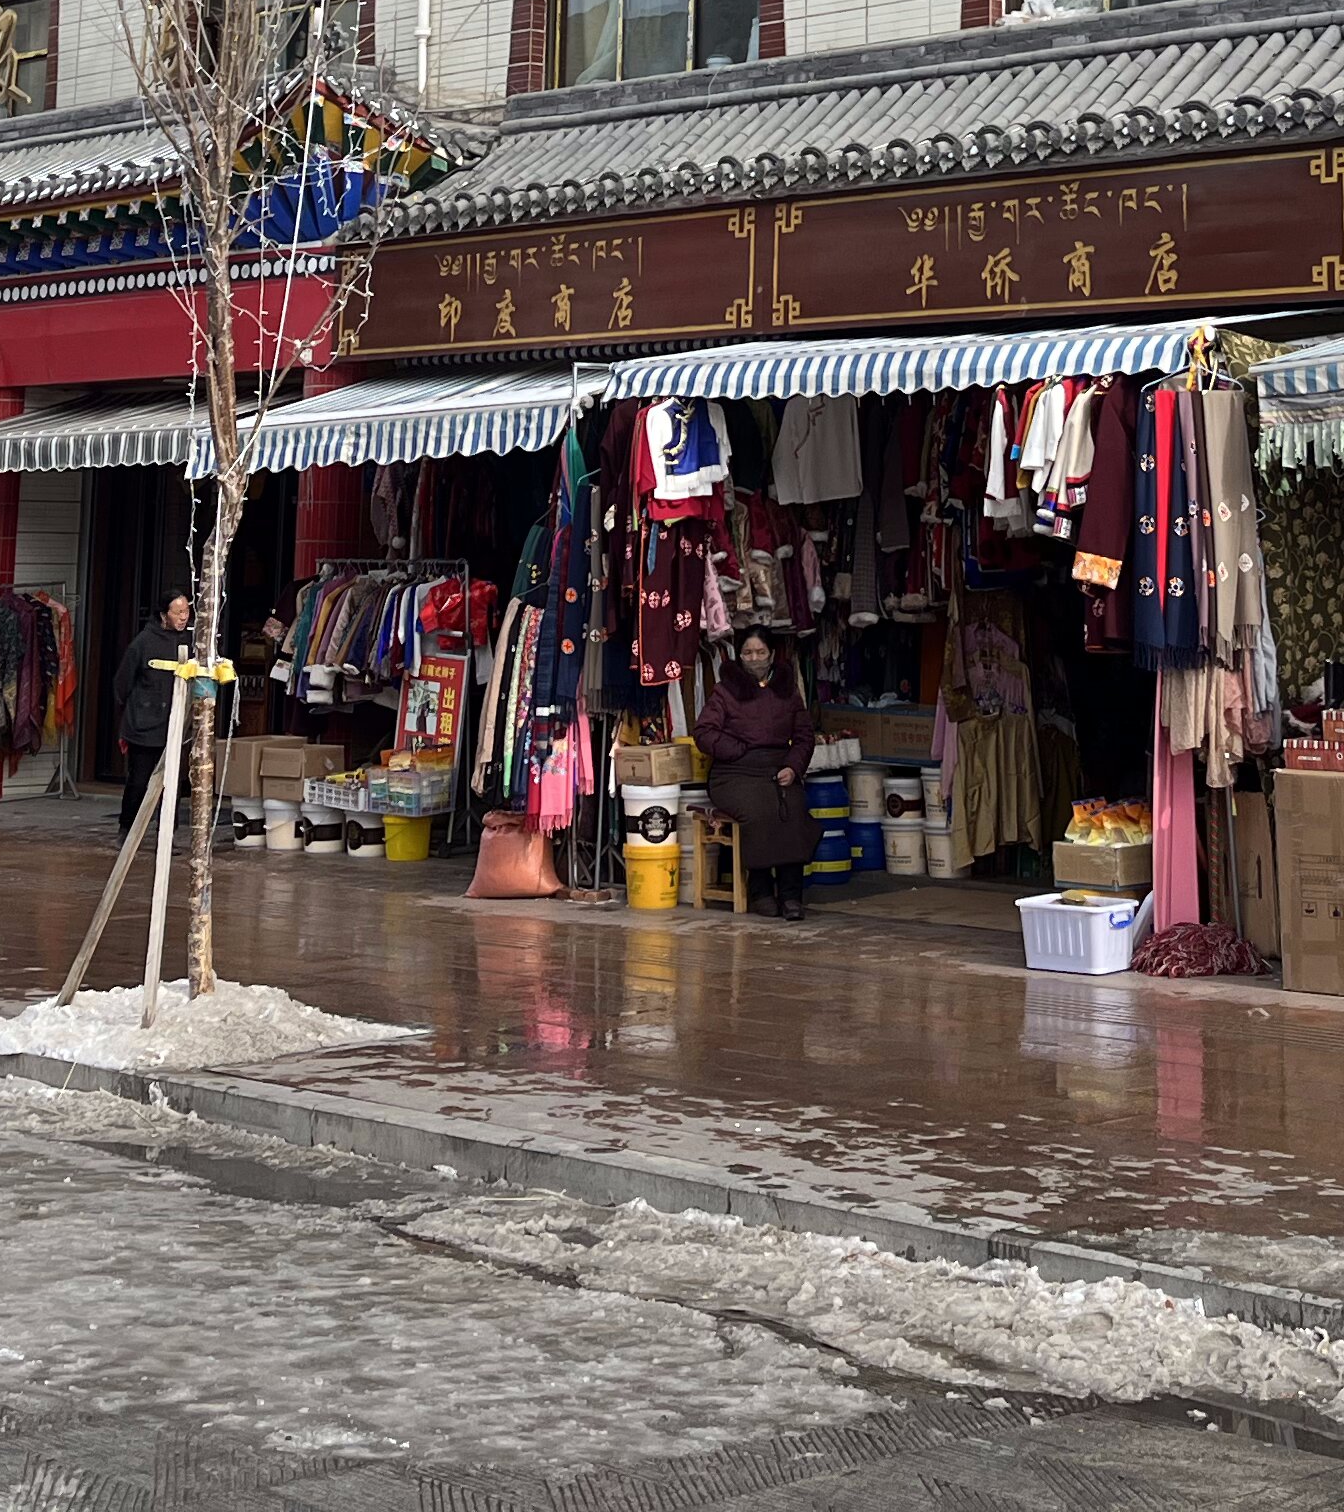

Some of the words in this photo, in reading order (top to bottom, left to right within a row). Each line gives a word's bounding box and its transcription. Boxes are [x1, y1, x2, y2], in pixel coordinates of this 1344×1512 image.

[905, 231, 1180, 308] 华侨商店
[438, 276, 635, 343] 印度商店
